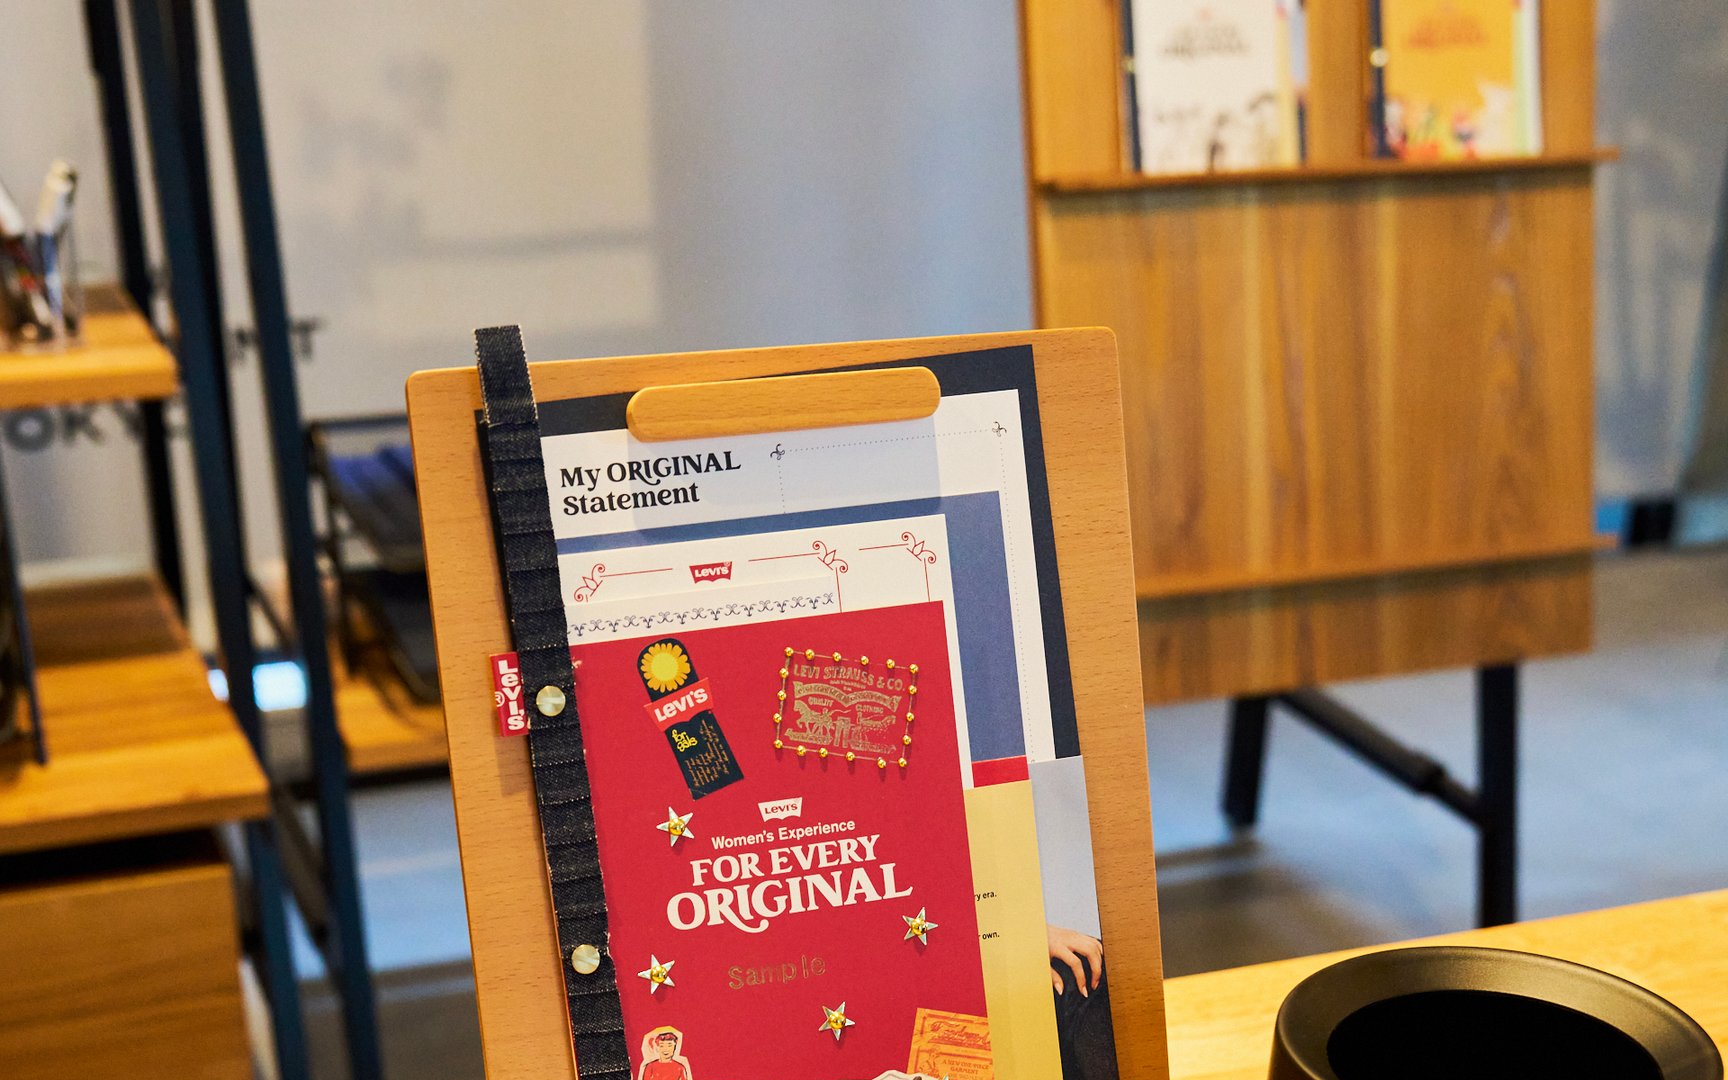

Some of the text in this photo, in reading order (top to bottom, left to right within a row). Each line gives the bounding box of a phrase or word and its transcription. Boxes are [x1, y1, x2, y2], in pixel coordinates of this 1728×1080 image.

[560, 451, 742, 491] My ORIGINAL
[563, 482, 700, 516] Statement
[793, 664, 820, 680] LEVI
[824, 665, 875, 686] STRAUSS
[876, 677, 886, 690] &
[711, 820, 856, 850] Women's Experience
[690, 834, 881, 887] FOR EVERY
[666, 862, 914, 933] ORIGINAL
[728, 954, 827, 990] Sample
